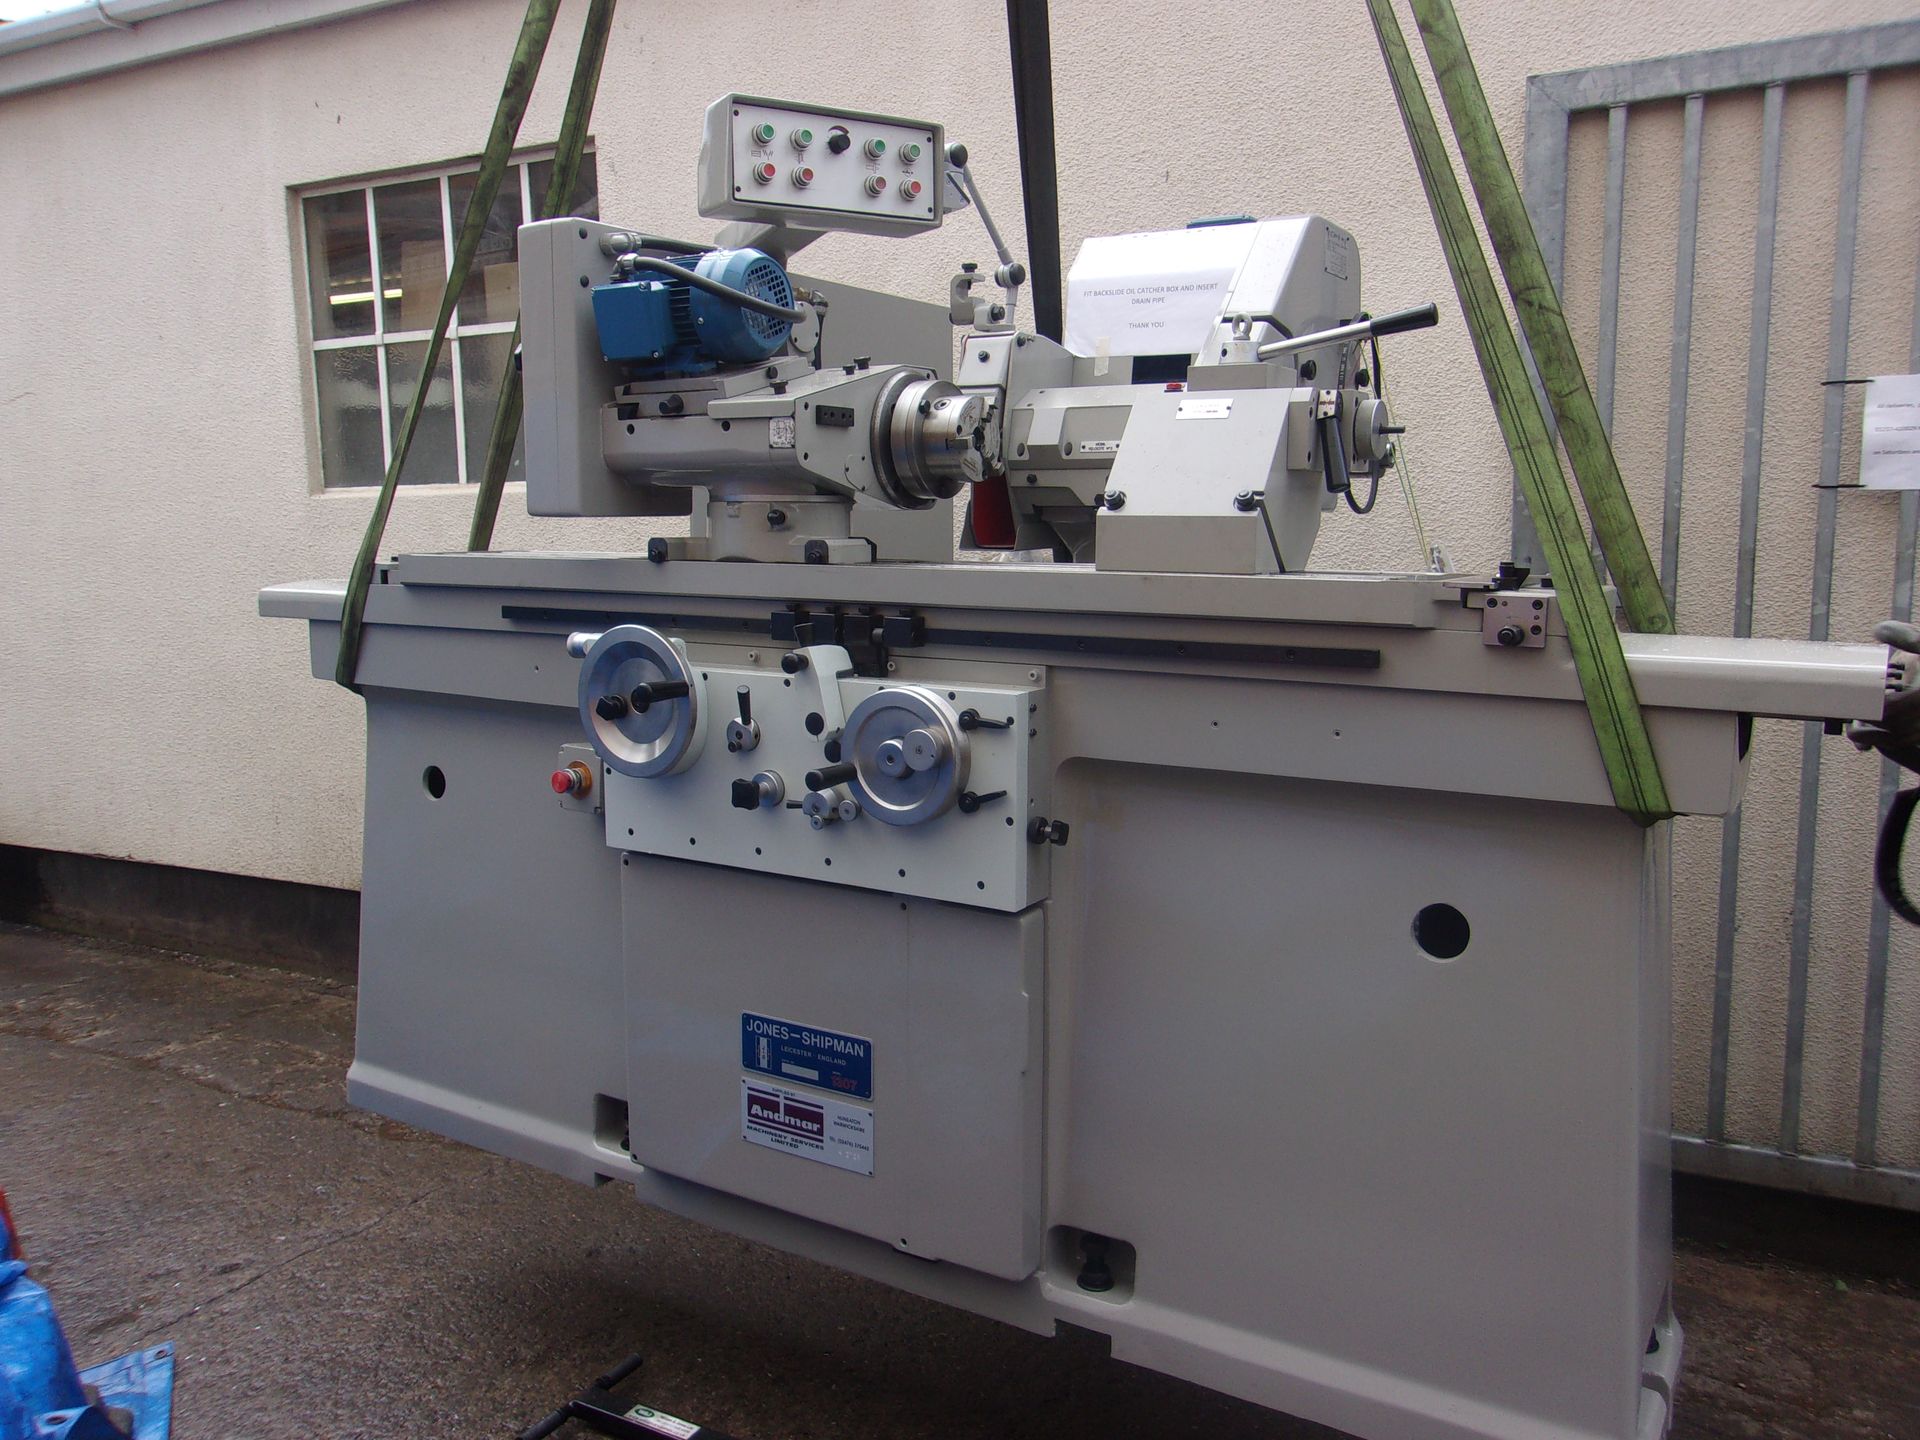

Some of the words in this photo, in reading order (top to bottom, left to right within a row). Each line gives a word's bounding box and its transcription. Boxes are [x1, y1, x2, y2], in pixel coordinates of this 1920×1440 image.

[1093, 288, 1125, 297] BACKSLIDE
[1125, 287, 1136, 295] OIL
[1137, 286, 1165, 295] CATCHER
[1166, 285, 1179, 293] BOX
[1180, 284, 1195, 292] AND
[1195, 283, 1218, 291] INSERT
[1131, 297, 1151, 305] DRAIN
[1152, 296, 1165, 304] PIPE
[780, 1044, 812, 1058] LEICESTER
[817, 1054, 847, 1066] ENGLAND
[750, 1101, 821, 1132] Andmar
[746, 1124, 788, 1140] MACHINERY
[790, 1136, 824, 1150] SERVICES
[770, 1137, 799, 1149] LIMITED
